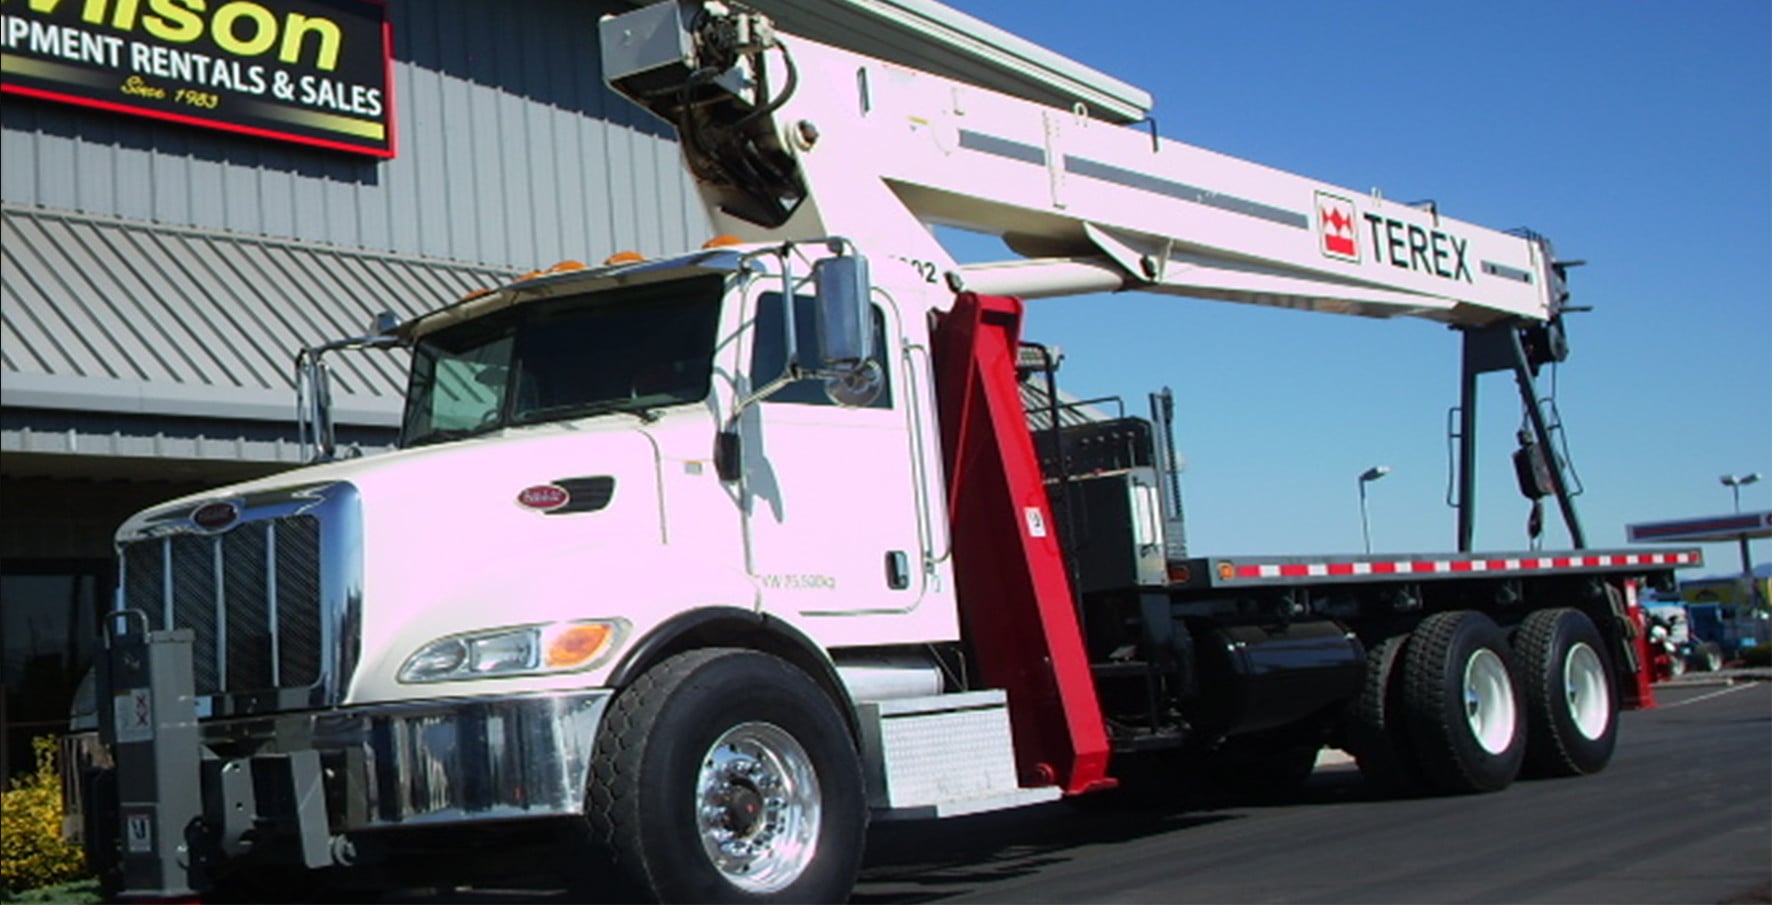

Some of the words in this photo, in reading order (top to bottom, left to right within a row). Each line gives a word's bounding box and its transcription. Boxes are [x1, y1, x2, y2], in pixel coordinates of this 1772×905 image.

[121, 76, 165, 100] Since
[175, 90, 219, 109] 1983
[132, 44, 266, 95] RENTALS
[273, 72, 294, 100] &
[301, 76, 382, 116] SALES
[1364, 213, 1472, 284] TEREX
